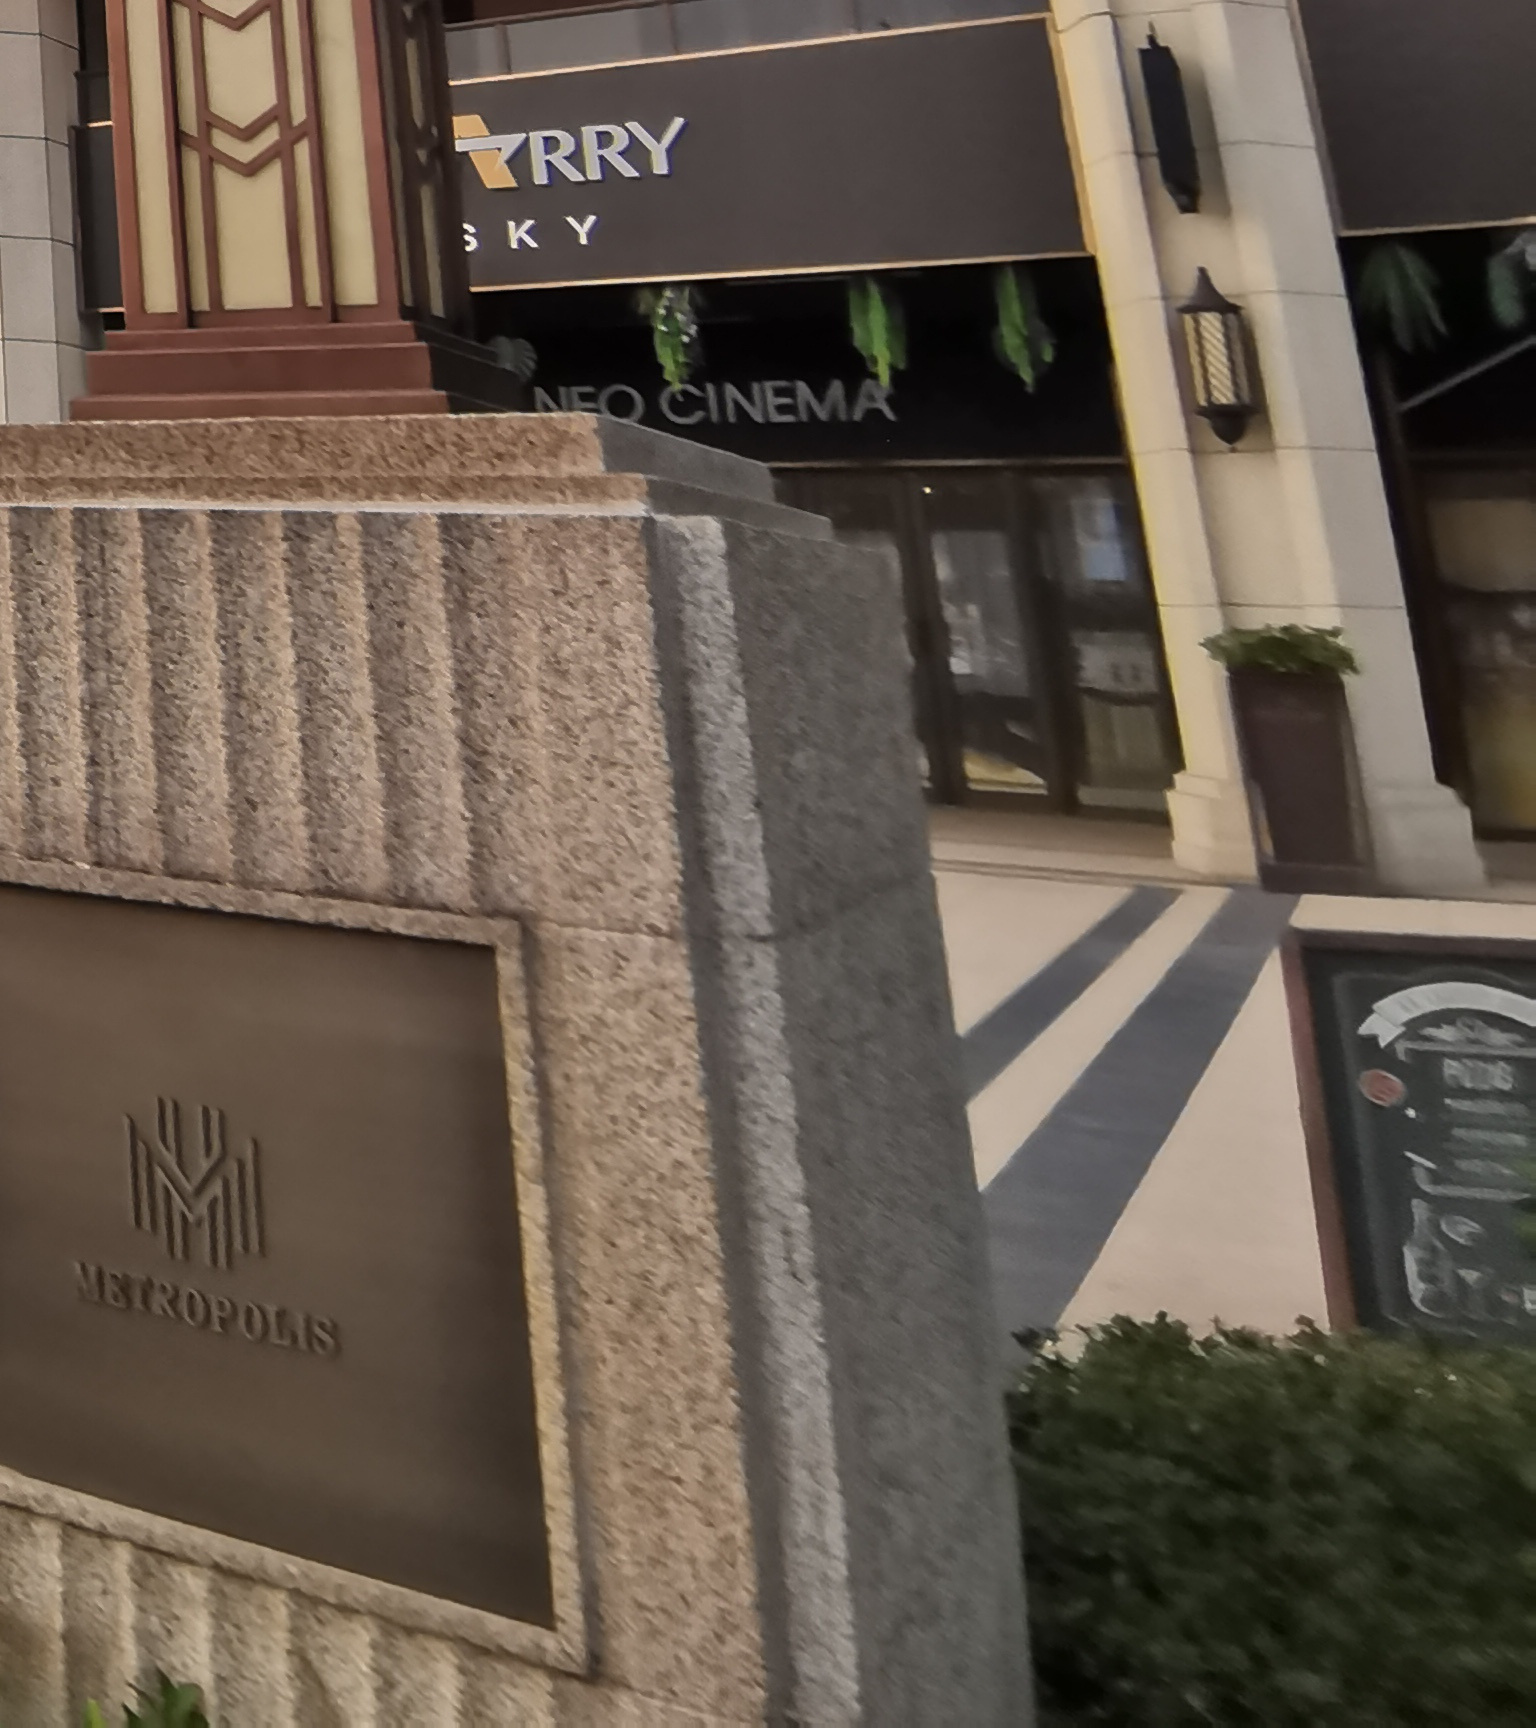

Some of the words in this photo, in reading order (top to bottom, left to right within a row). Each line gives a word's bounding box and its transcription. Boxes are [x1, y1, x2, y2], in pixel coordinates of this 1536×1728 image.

[533, 383, 646, 423] NEO
[659, 379, 897, 425] CINEMA
[72, 1260, 341, 1358] METROPOLIS
